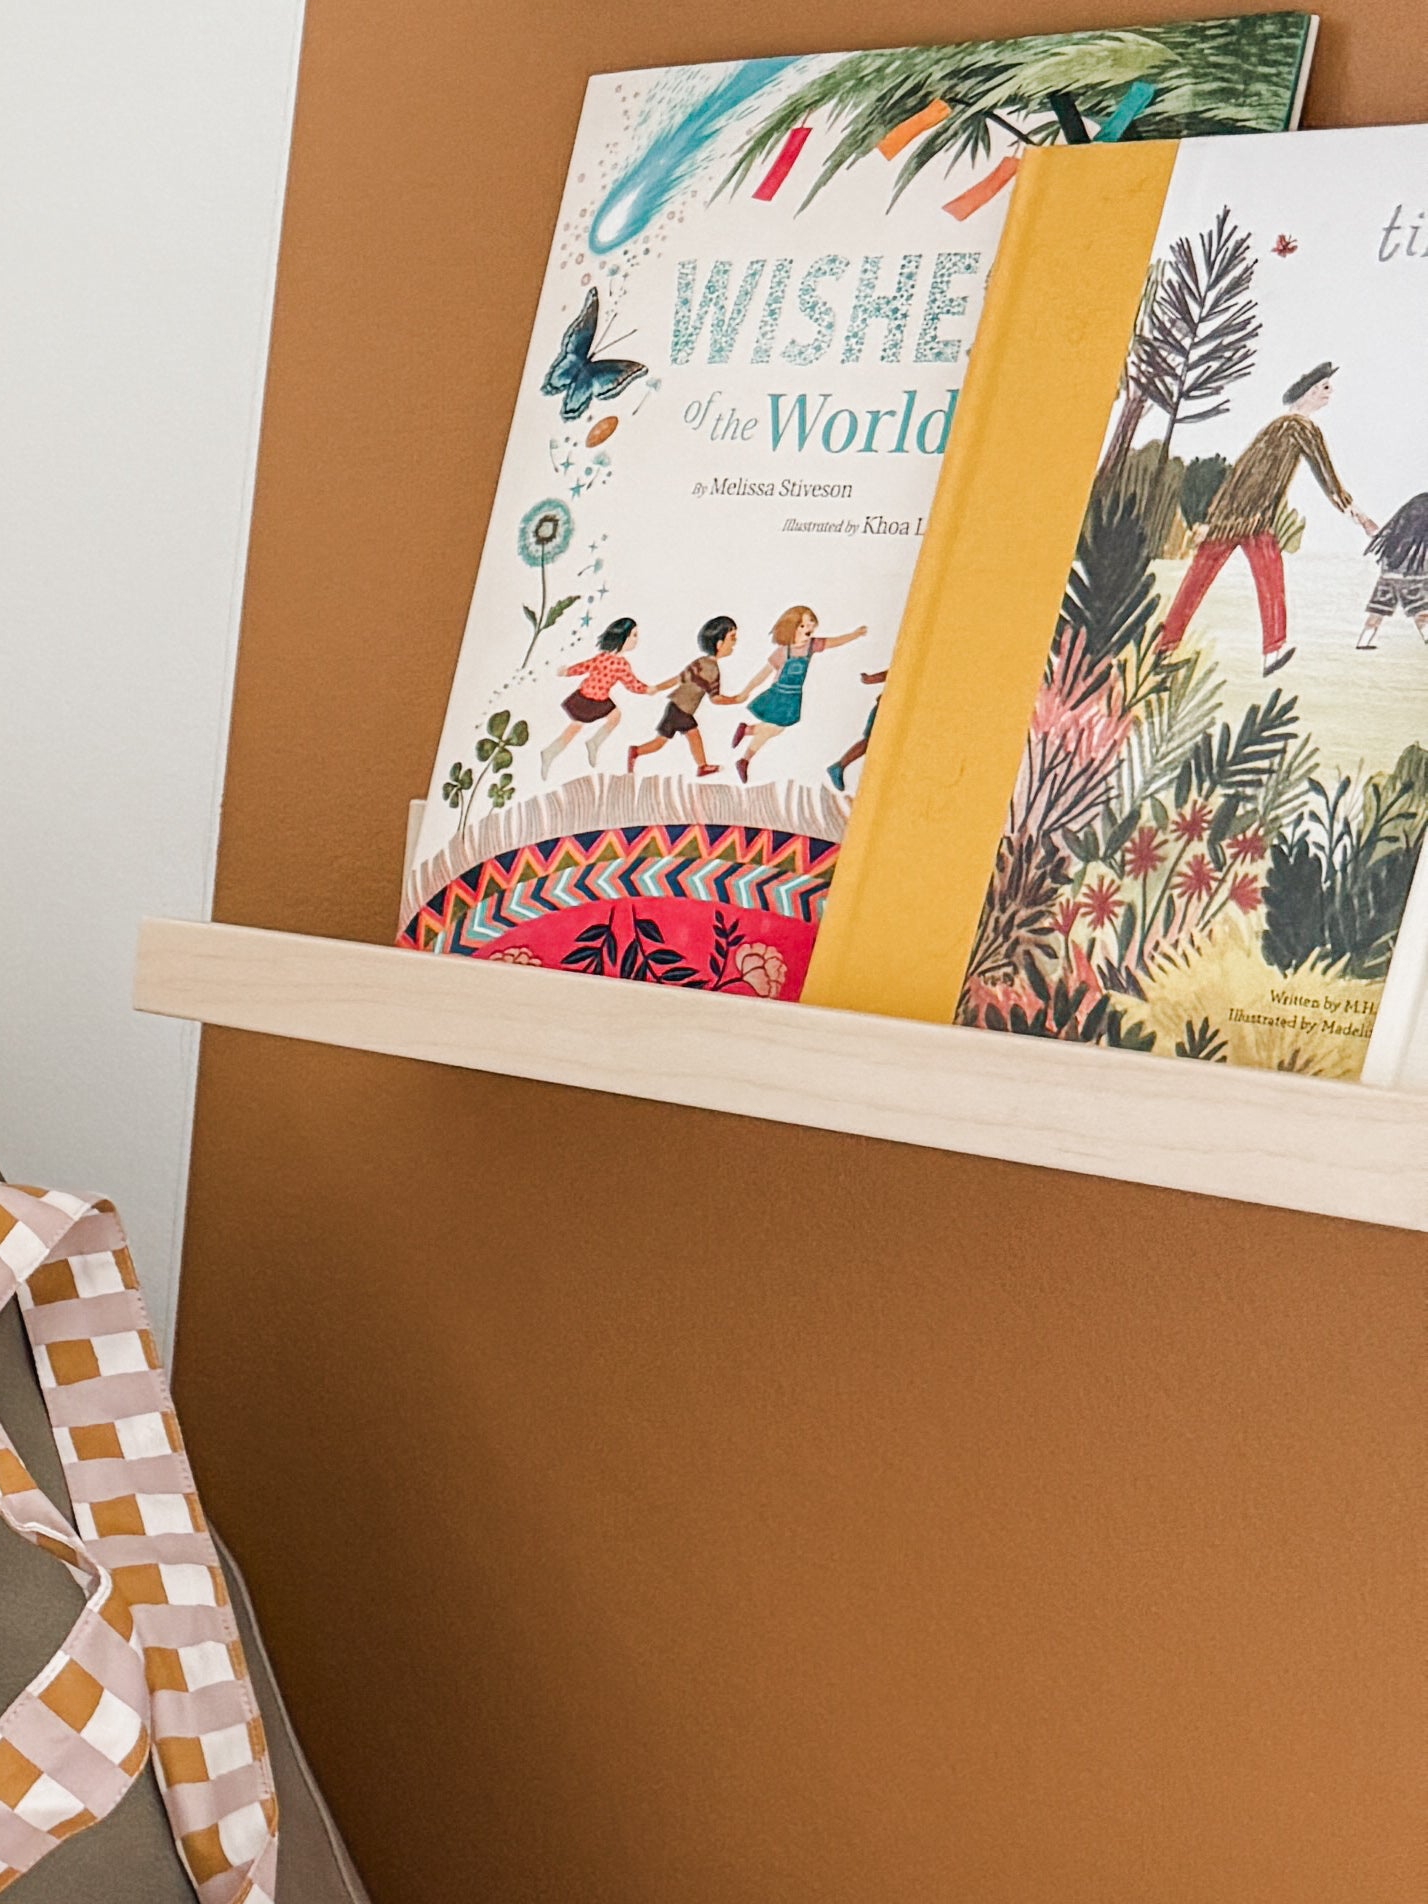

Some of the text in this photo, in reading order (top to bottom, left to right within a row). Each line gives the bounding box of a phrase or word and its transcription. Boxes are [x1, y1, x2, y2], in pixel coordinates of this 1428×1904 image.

[1378, 204, 1428, 262] ti
[670, 252, 993, 366] WISHE
[683, 388, 960, 455] of the World
[710, 477, 775, 497] Melissa
[778, 478, 853, 498] Stiveson
[782, 518, 843, 533] Illustrated
[844, 518, 860, 537] by
[862, 516, 909, 536] Khoa
[1270, 989, 1320, 1010] Written
[1324, 996, 1341, 1014] by
[1228, 1008, 1297, 1029] Illustrated
[1300, 1016, 1317, 1034] by
